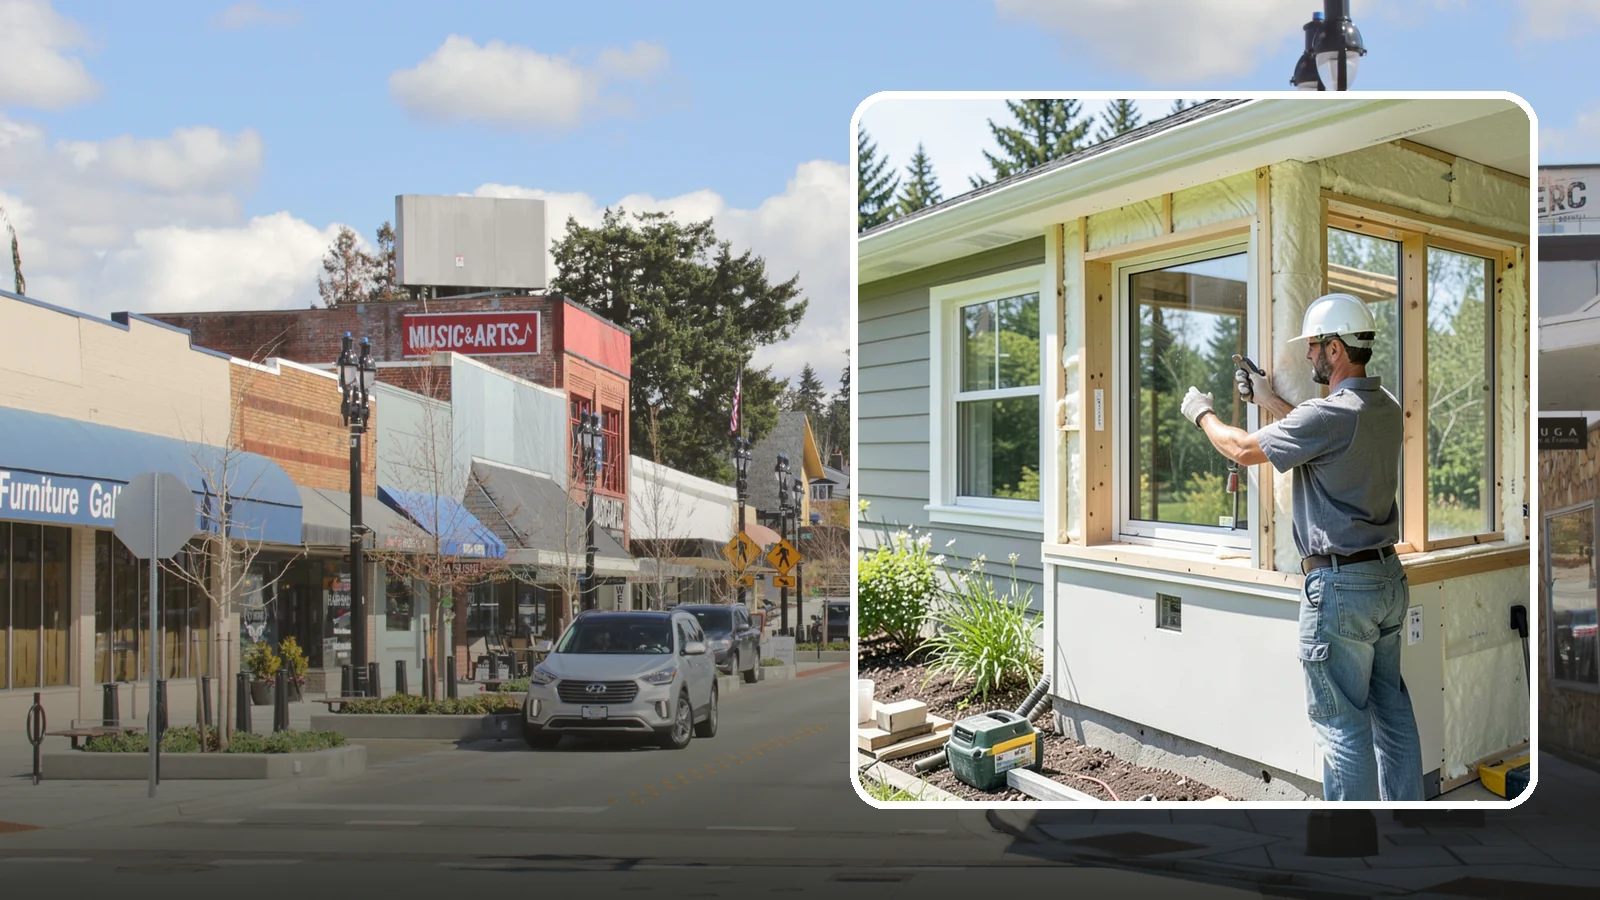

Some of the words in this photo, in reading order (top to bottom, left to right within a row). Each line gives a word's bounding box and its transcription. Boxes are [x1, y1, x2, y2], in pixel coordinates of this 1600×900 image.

[408, 322, 520, 349] MUSIC&ARTS
[1540, 427, 1578, 437] UGA
[0, 471, 80, 515] Furniture
[453, 563, 479, 574] SUSHI
